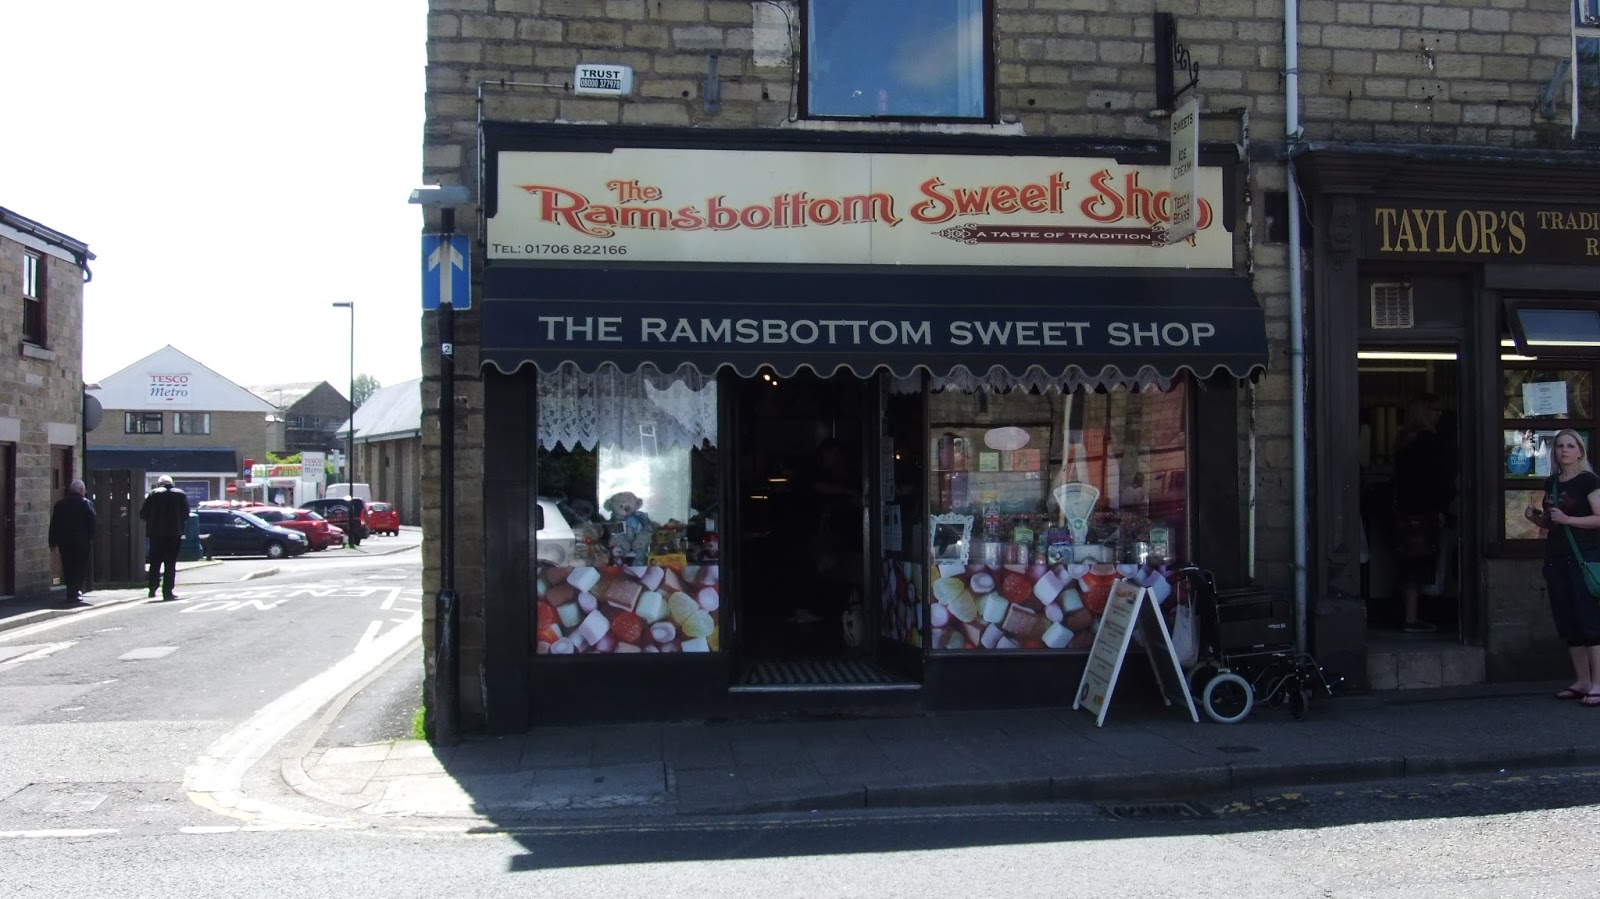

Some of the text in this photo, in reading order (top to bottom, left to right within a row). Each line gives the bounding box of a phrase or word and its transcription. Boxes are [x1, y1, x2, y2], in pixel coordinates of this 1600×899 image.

[581, 69, 621, 79] TRUST
[1173, 112, 1194, 136] SWEETS
[1178, 147, 1188, 162] ICE
[1173, 160, 1192, 181] CREAM
[607, 179, 663, 204] The
[513, 183, 901, 238] Ramsbottom
[911, 170, 1070, 224] Sweet
[1173, 208, 1190, 226] BEARS
[990, 231, 1039, 239] TASTE
[1068, 232, 1151, 240] TRADITION
[1374, 207, 1527, 255] TAYLOR'S
[525, 244, 569, 255] 01706
[573, 244, 627, 255] 822166
[538, 316, 1215, 347] THE RAMSBOTTOM SWEET SHOP
[150, 375, 190, 383] TESCO
[150, 387, 189, 397] Metro
